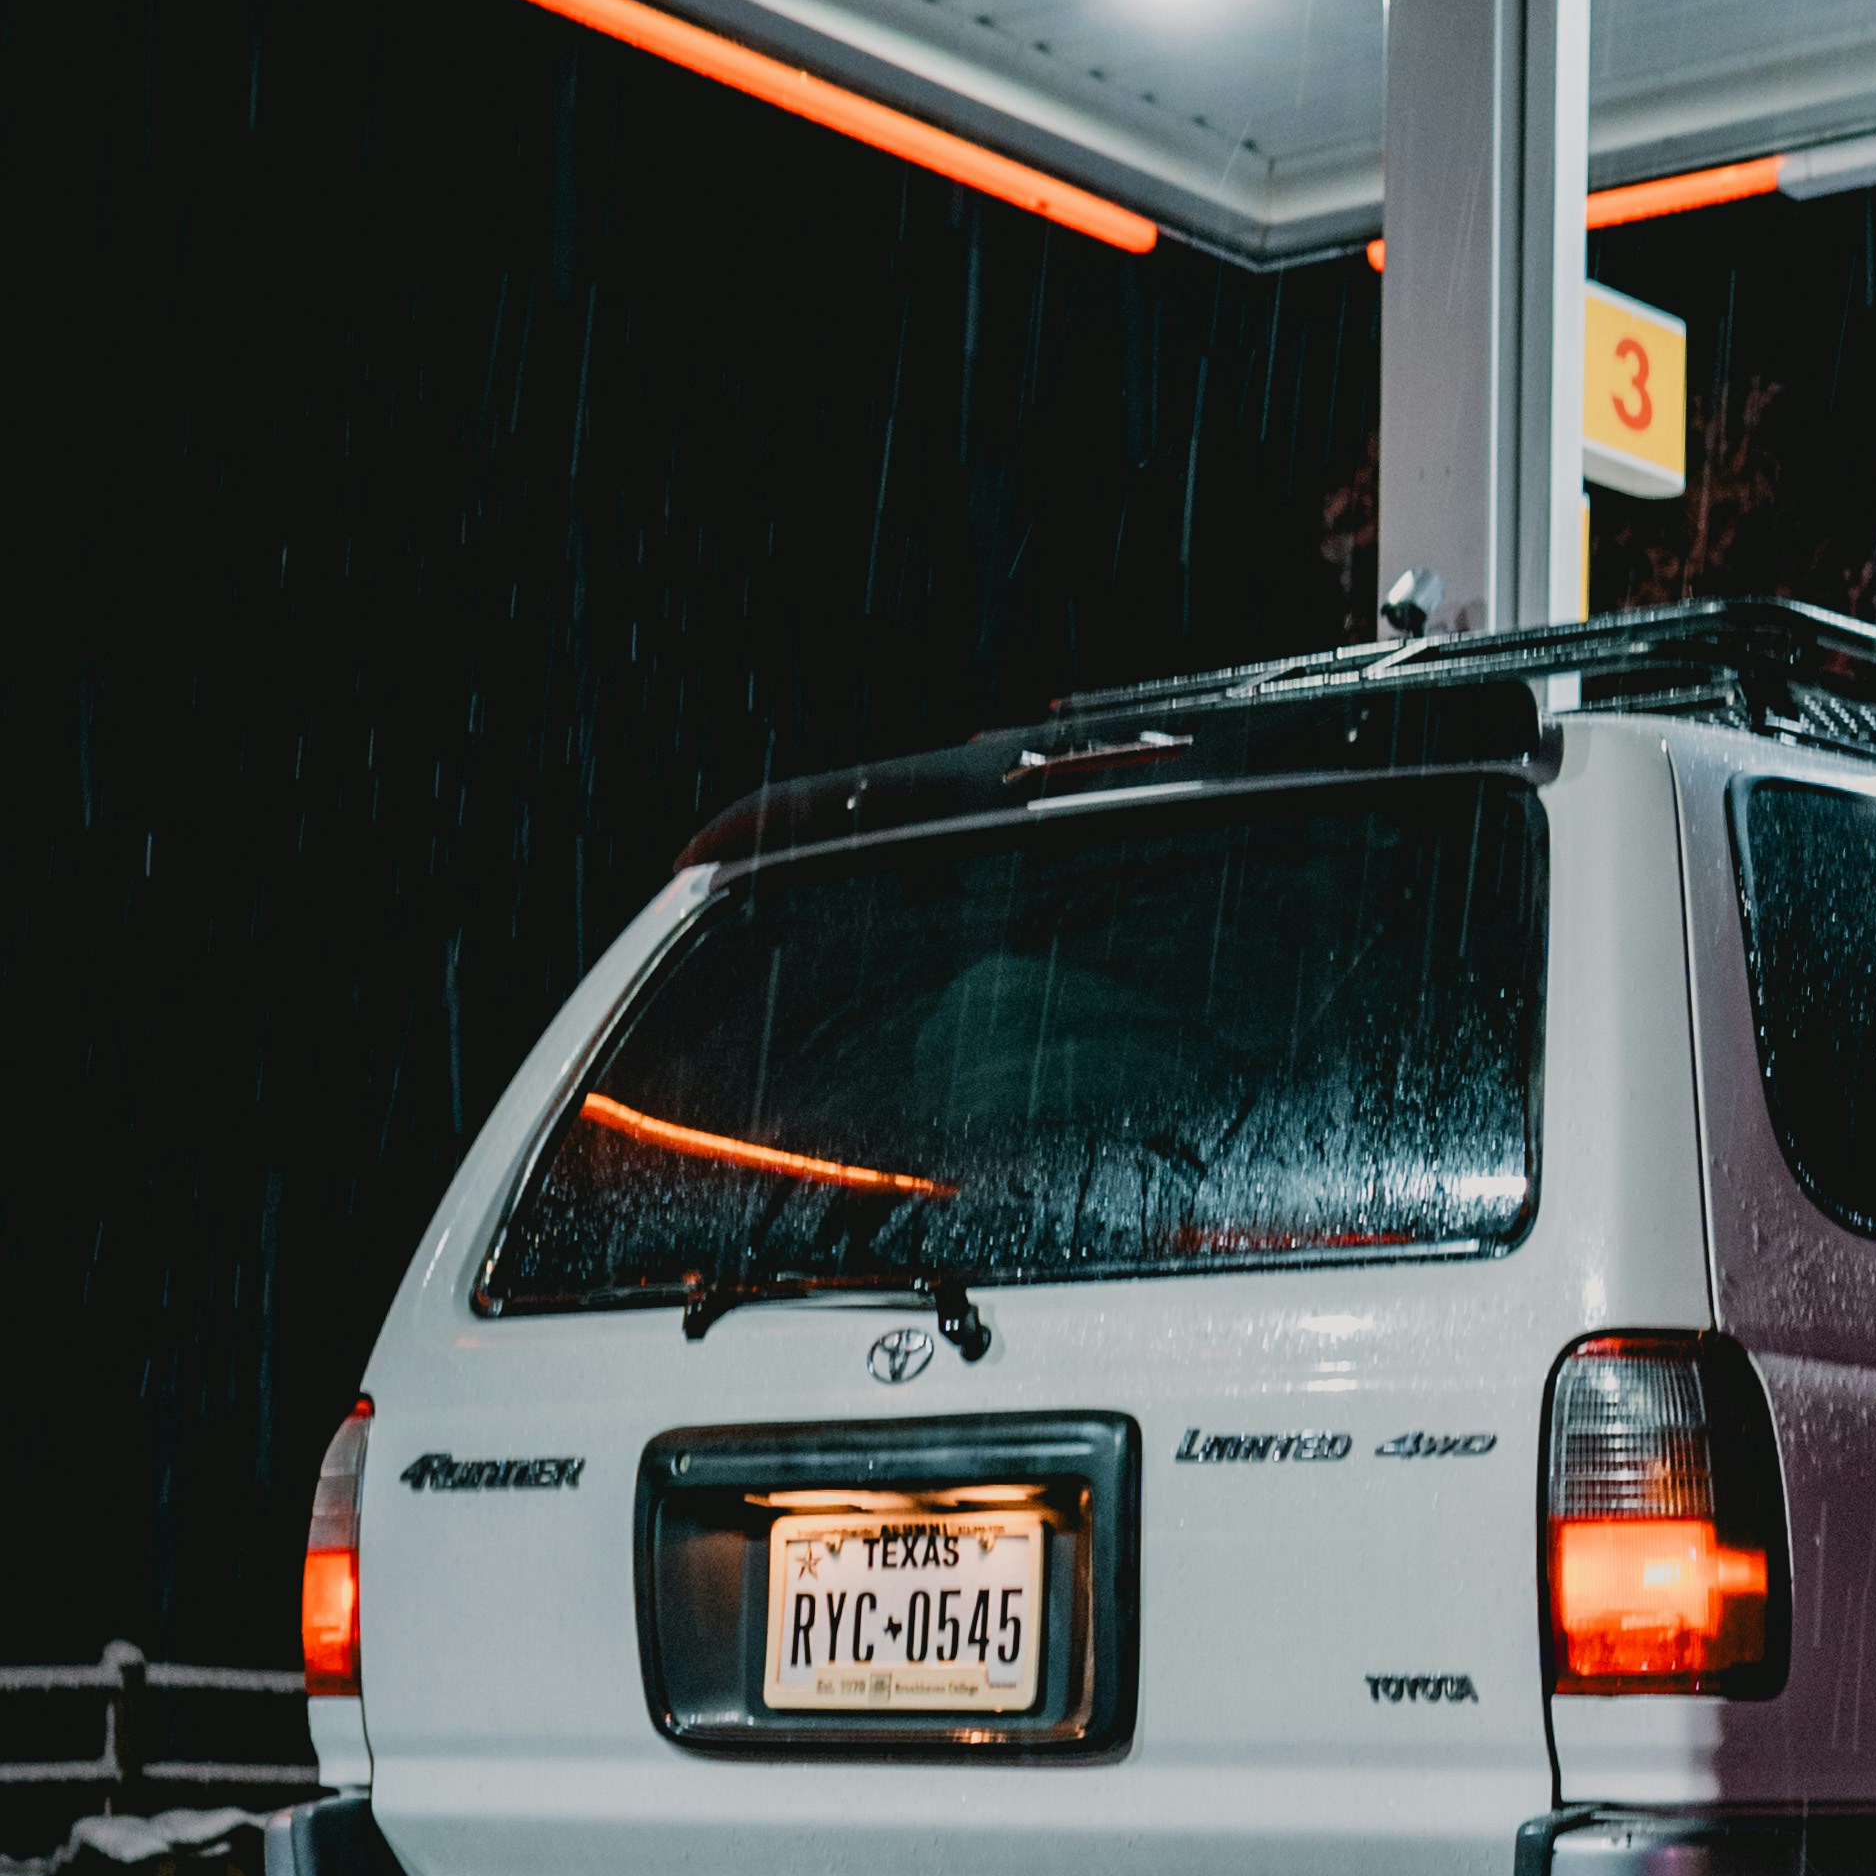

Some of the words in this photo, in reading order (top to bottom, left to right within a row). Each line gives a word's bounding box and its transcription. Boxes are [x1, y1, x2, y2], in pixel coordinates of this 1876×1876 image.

[1612, 337, 1653, 431] 3
[1175, 1428, 1353, 1463] LIMITED
[1374, 1430, 1497, 1458] 4WD
[863, 1536, 960, 1569] TEXAS
[1364, 1674, 1479, 1703] TOYOTA
